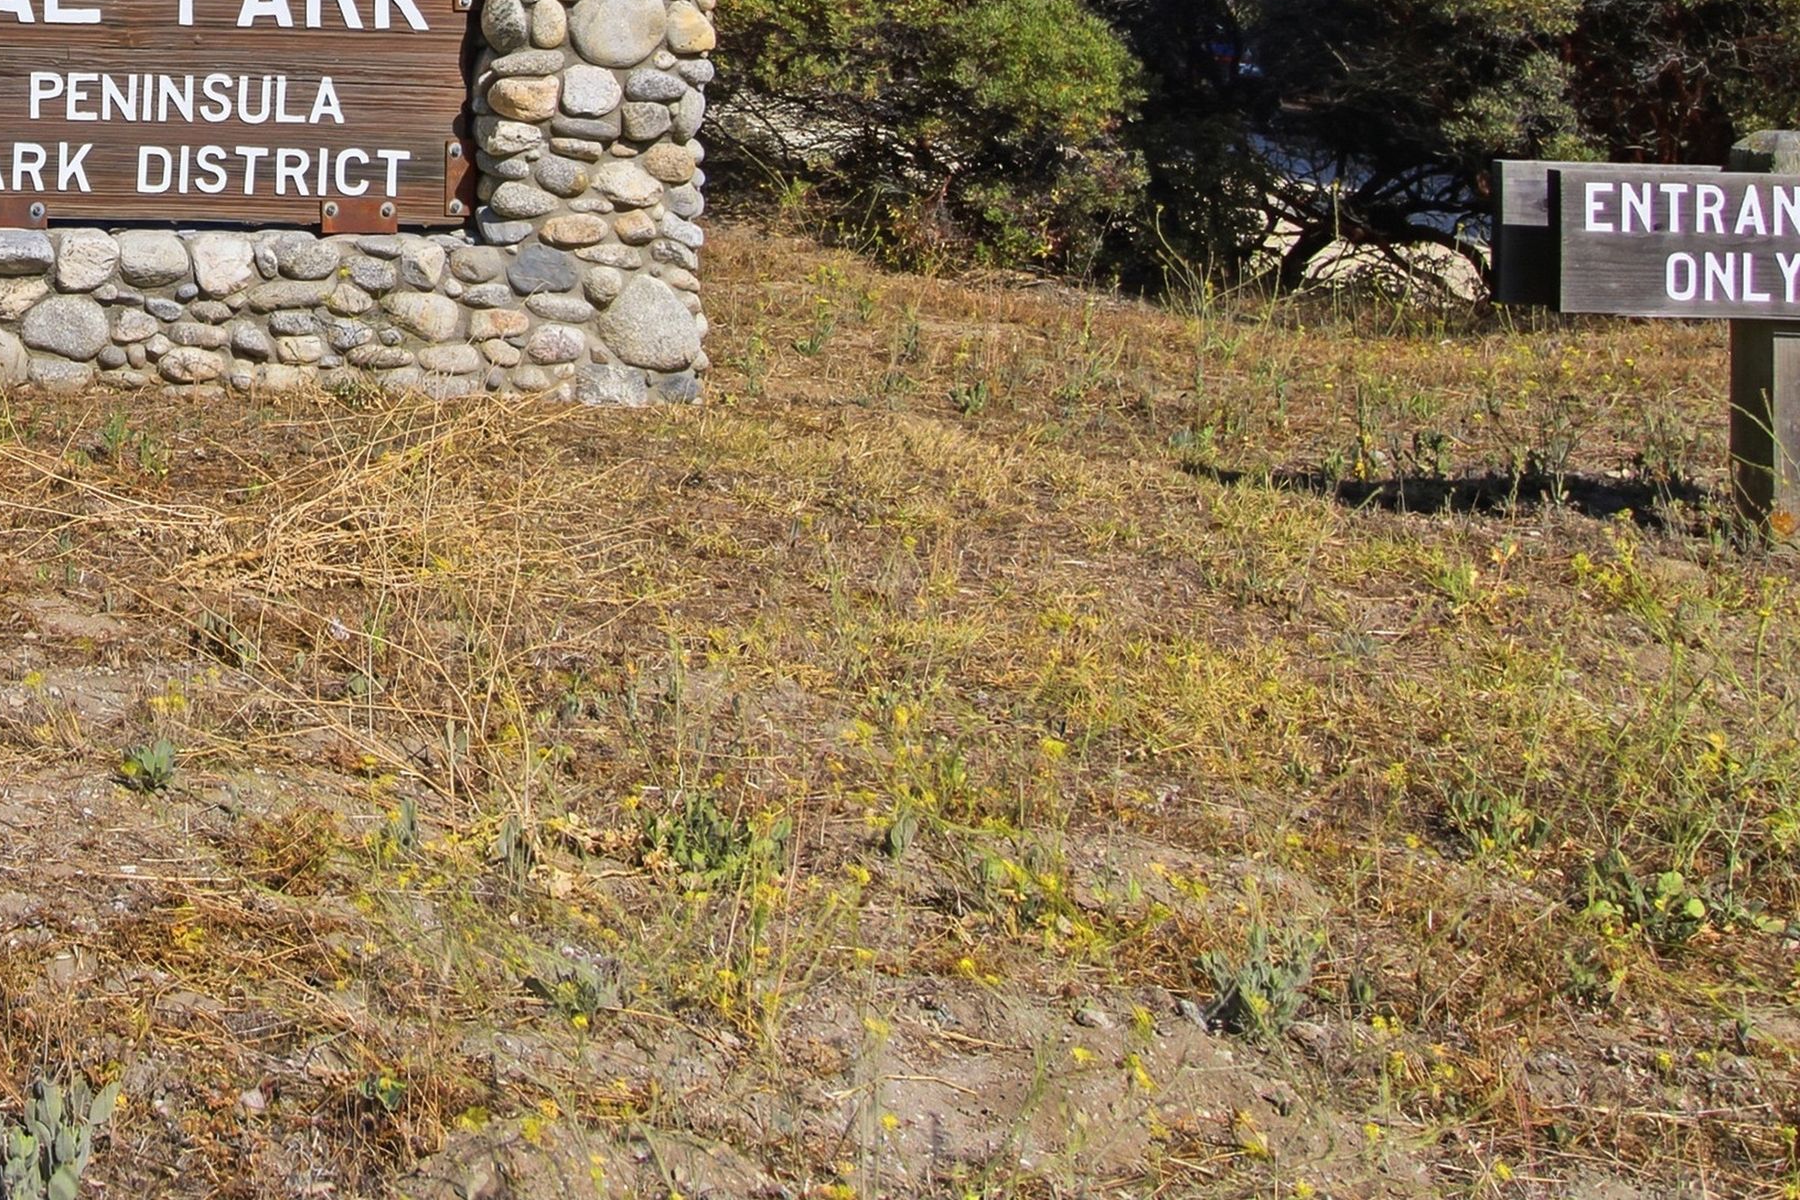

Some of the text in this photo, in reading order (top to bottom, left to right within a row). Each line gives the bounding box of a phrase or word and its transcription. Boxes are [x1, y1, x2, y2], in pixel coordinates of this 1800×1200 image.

[29, 71, 345, 124] PENINSULA
[137, 145, 411, 197] DISTRICT
[1665, 251, 1800, 304] ONLY
